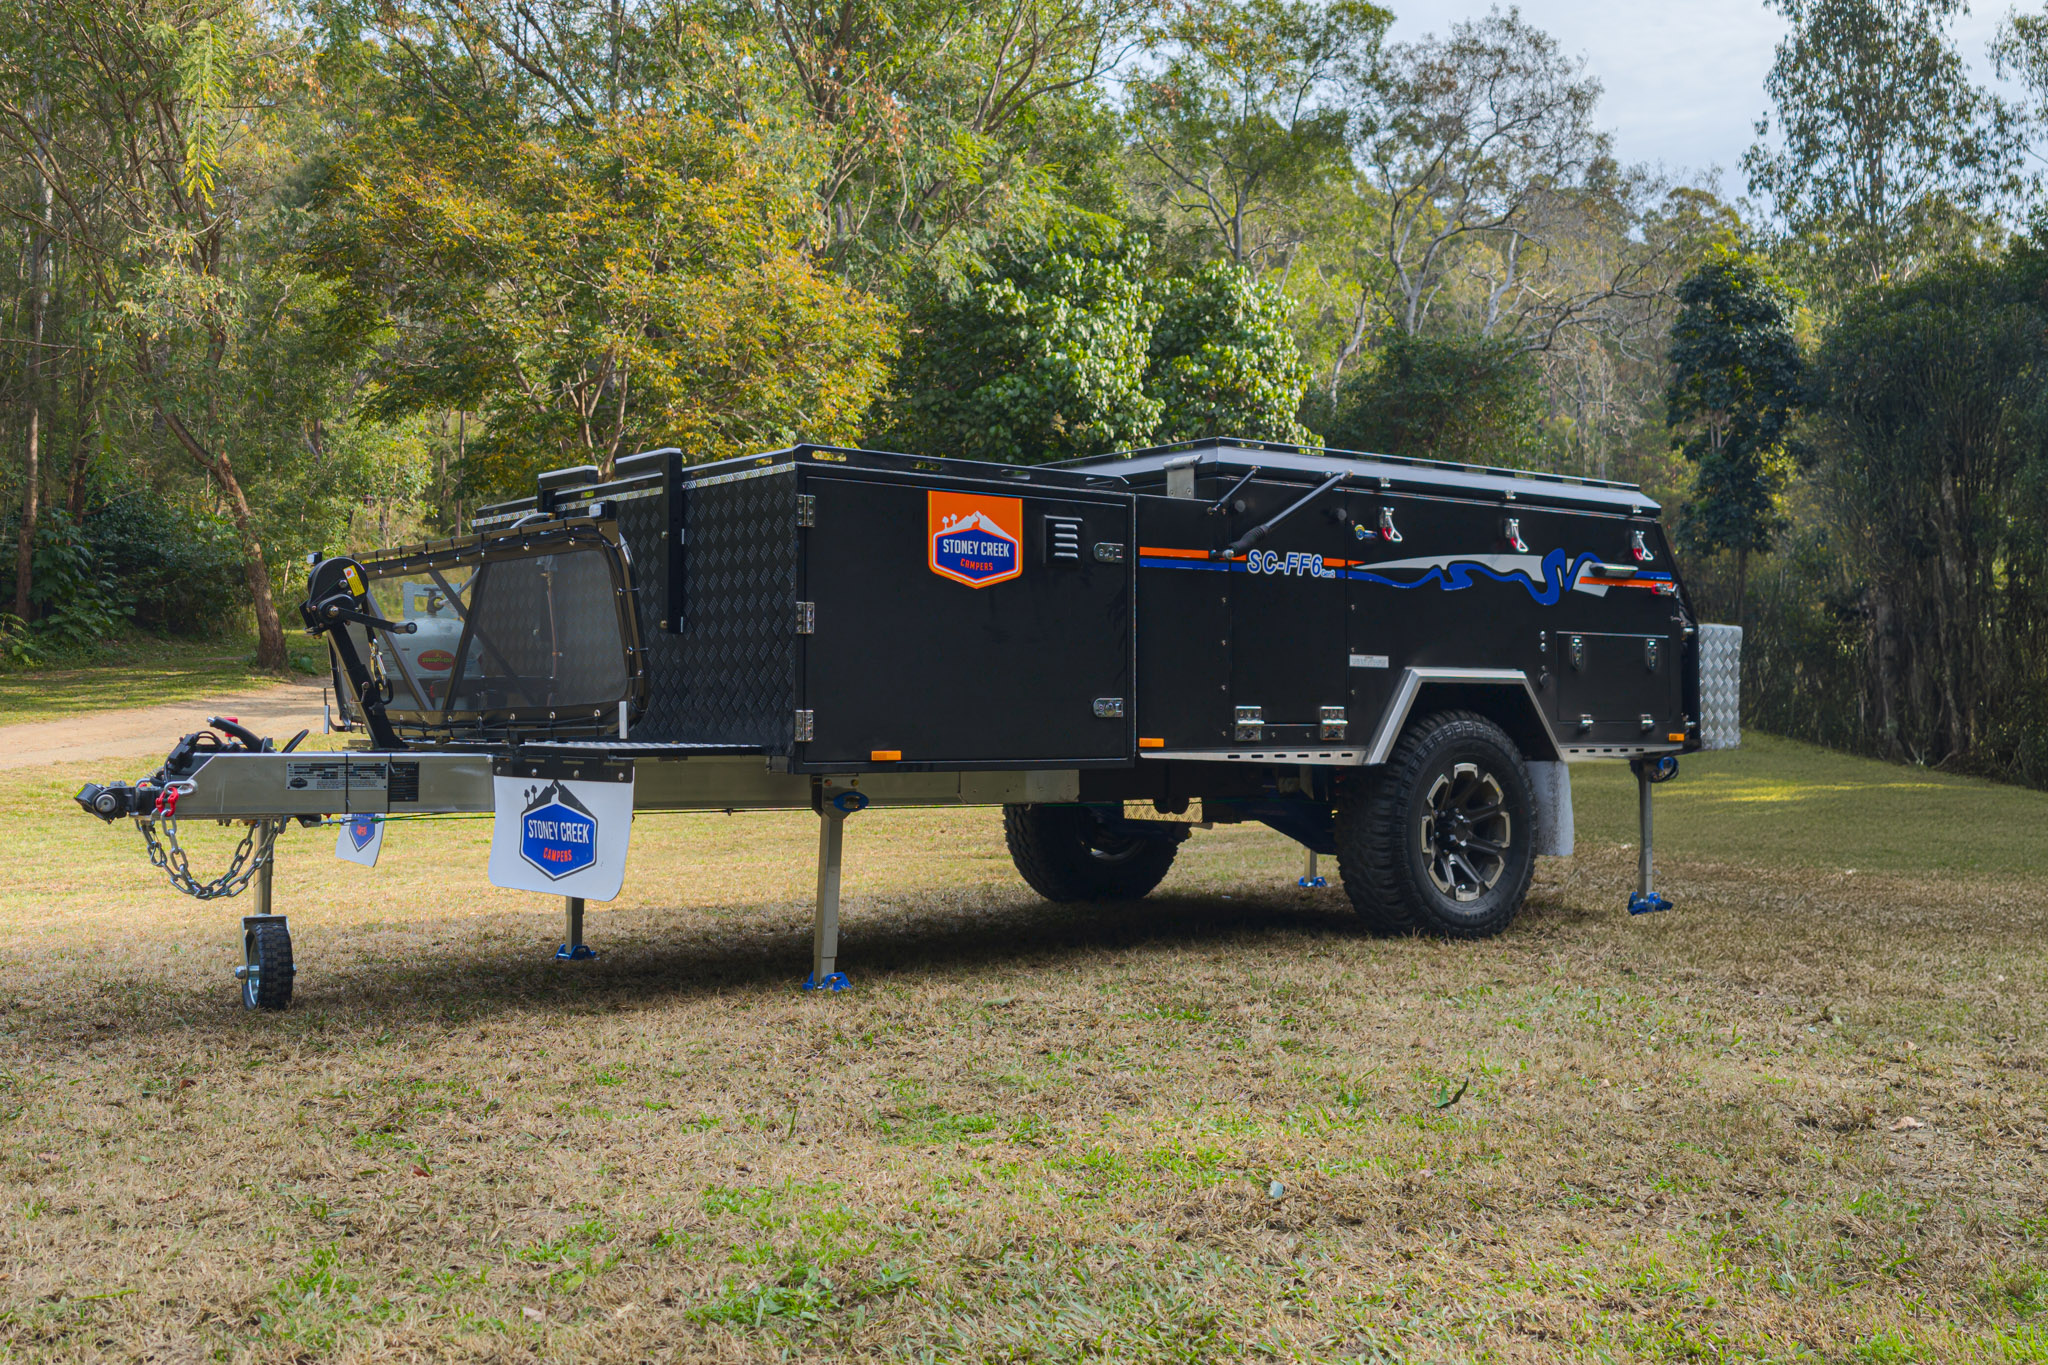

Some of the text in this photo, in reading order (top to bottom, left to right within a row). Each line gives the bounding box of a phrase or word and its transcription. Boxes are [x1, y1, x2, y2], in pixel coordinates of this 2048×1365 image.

[943, 538, 1010, 558] STONEY CREEK
[960, 558, 994, 571] CAMPERS
[1247, 549, 1323, 578] SC-FF6
[528, 819, 590, 844] STONEY CREEK
[542, 847, 573, 863] CAMPERS
